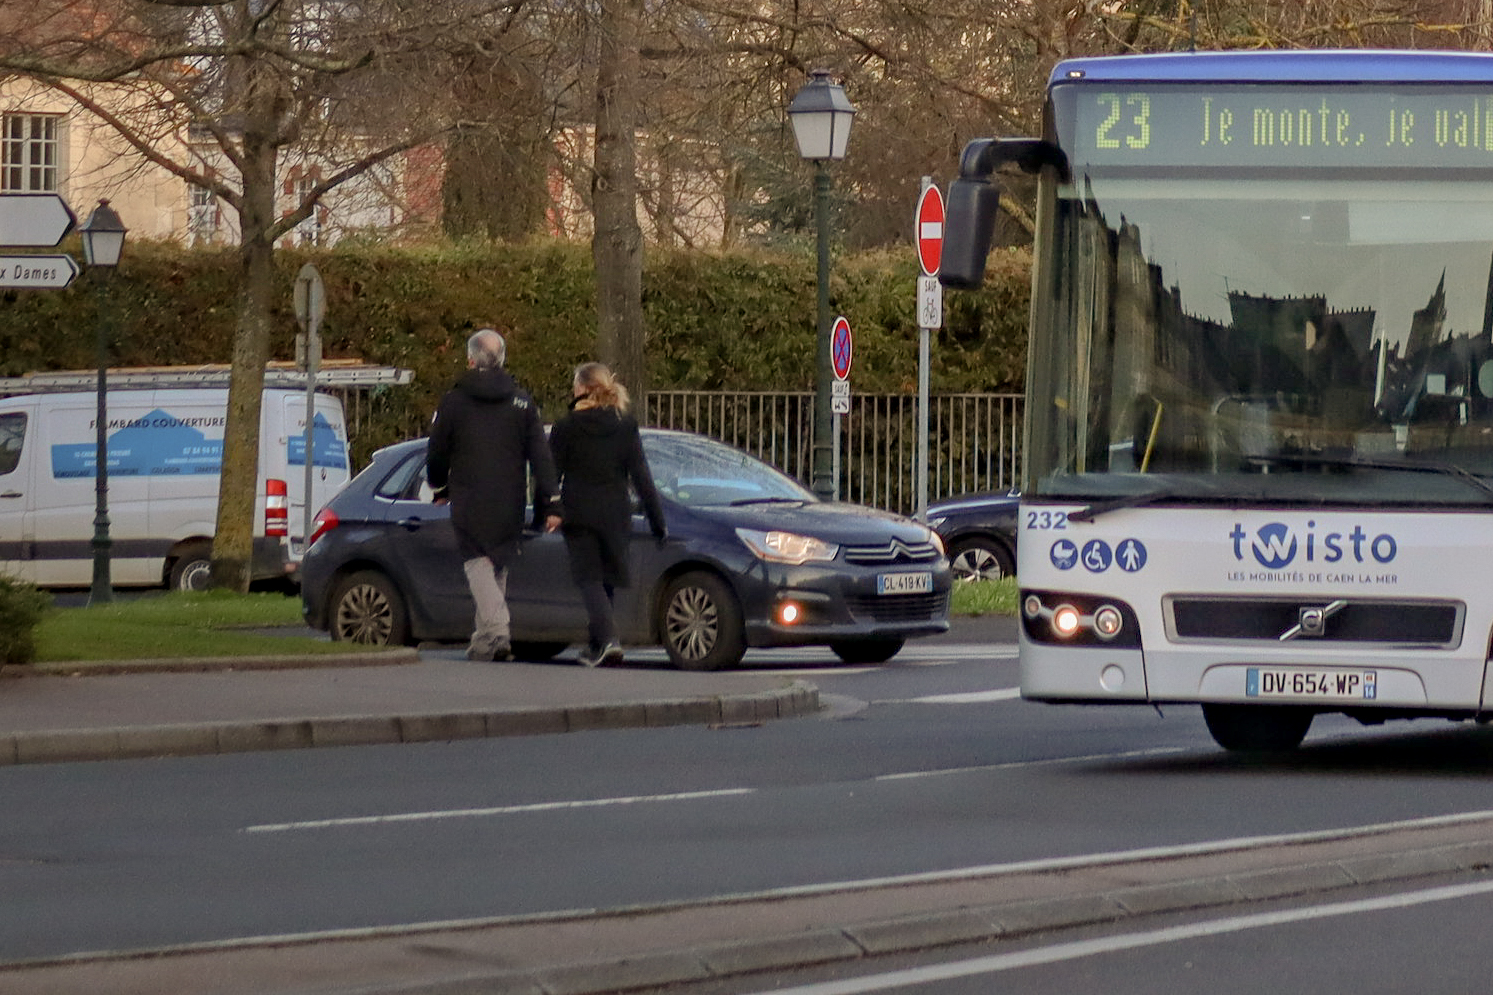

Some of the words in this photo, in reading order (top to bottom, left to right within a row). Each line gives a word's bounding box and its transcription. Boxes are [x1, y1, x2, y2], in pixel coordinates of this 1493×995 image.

[1096, 93, 1150, 149] 23
[1200, 96, 1233, 145] Je
[1253, 96, 1365, 147] monte,
[1386, 96, 1415, 147] je
[14, 264, 57, 280] Dames
[924, 279, 937, 292] SAUF
[152, 417, 226, 429] COUVERTURE
[1027, 511, 1067, 530] 232
[1229, 520, 1398, 570] twisto
[1227, 571, 1245, 582] LES
[1249, 570, 1304, 583] MOBILITÉS
[1308, 572, 1322, 583] DE
[1326, 573, 1355, 583] CAEN
[1358, 574, 1372, 584] LA
[1376, 574, 1398, 584] MER
